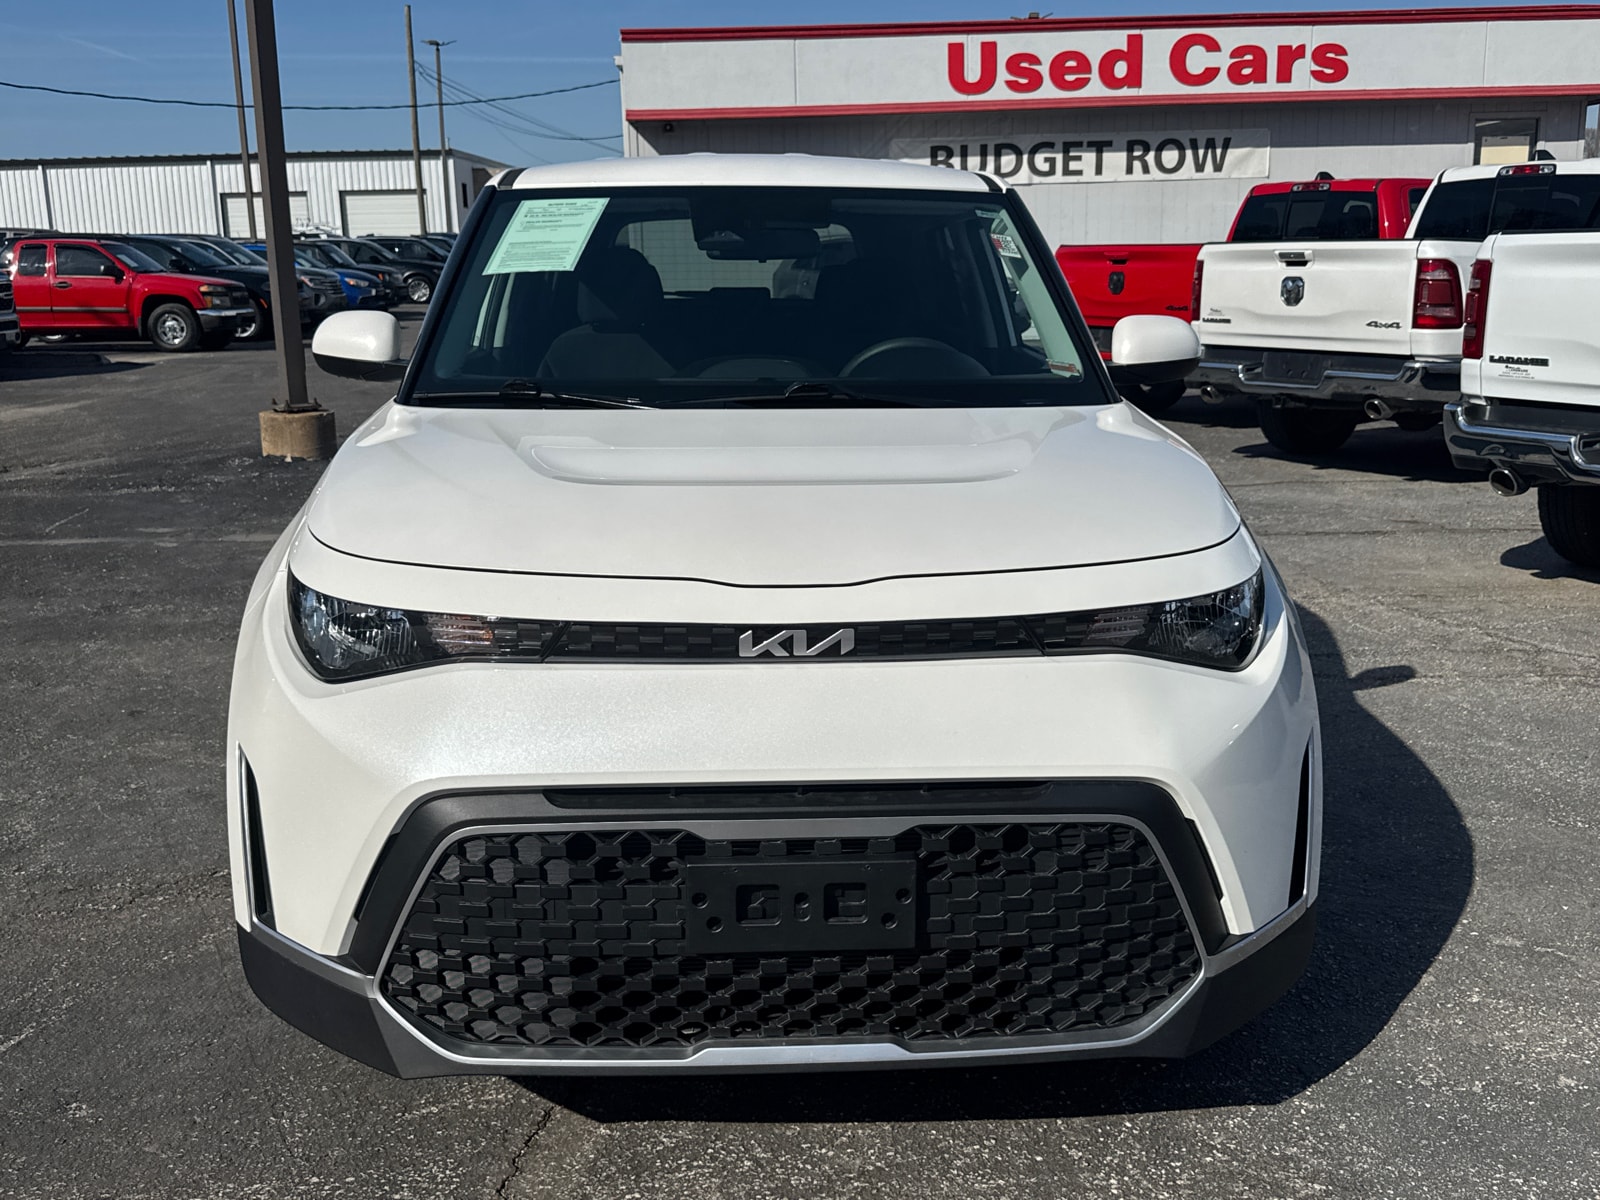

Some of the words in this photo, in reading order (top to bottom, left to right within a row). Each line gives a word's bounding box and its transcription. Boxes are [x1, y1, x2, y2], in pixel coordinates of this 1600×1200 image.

[947, 34, 1143, 95] Used
[1169, 33, 1349, 87] Cars
[930, 140, 1113, 178] BUDGET
[1126, 137, 1232, 176] ROW
[1366, 320, 1402, 329] 4x4
[738, 628, 855, 657] KIA
